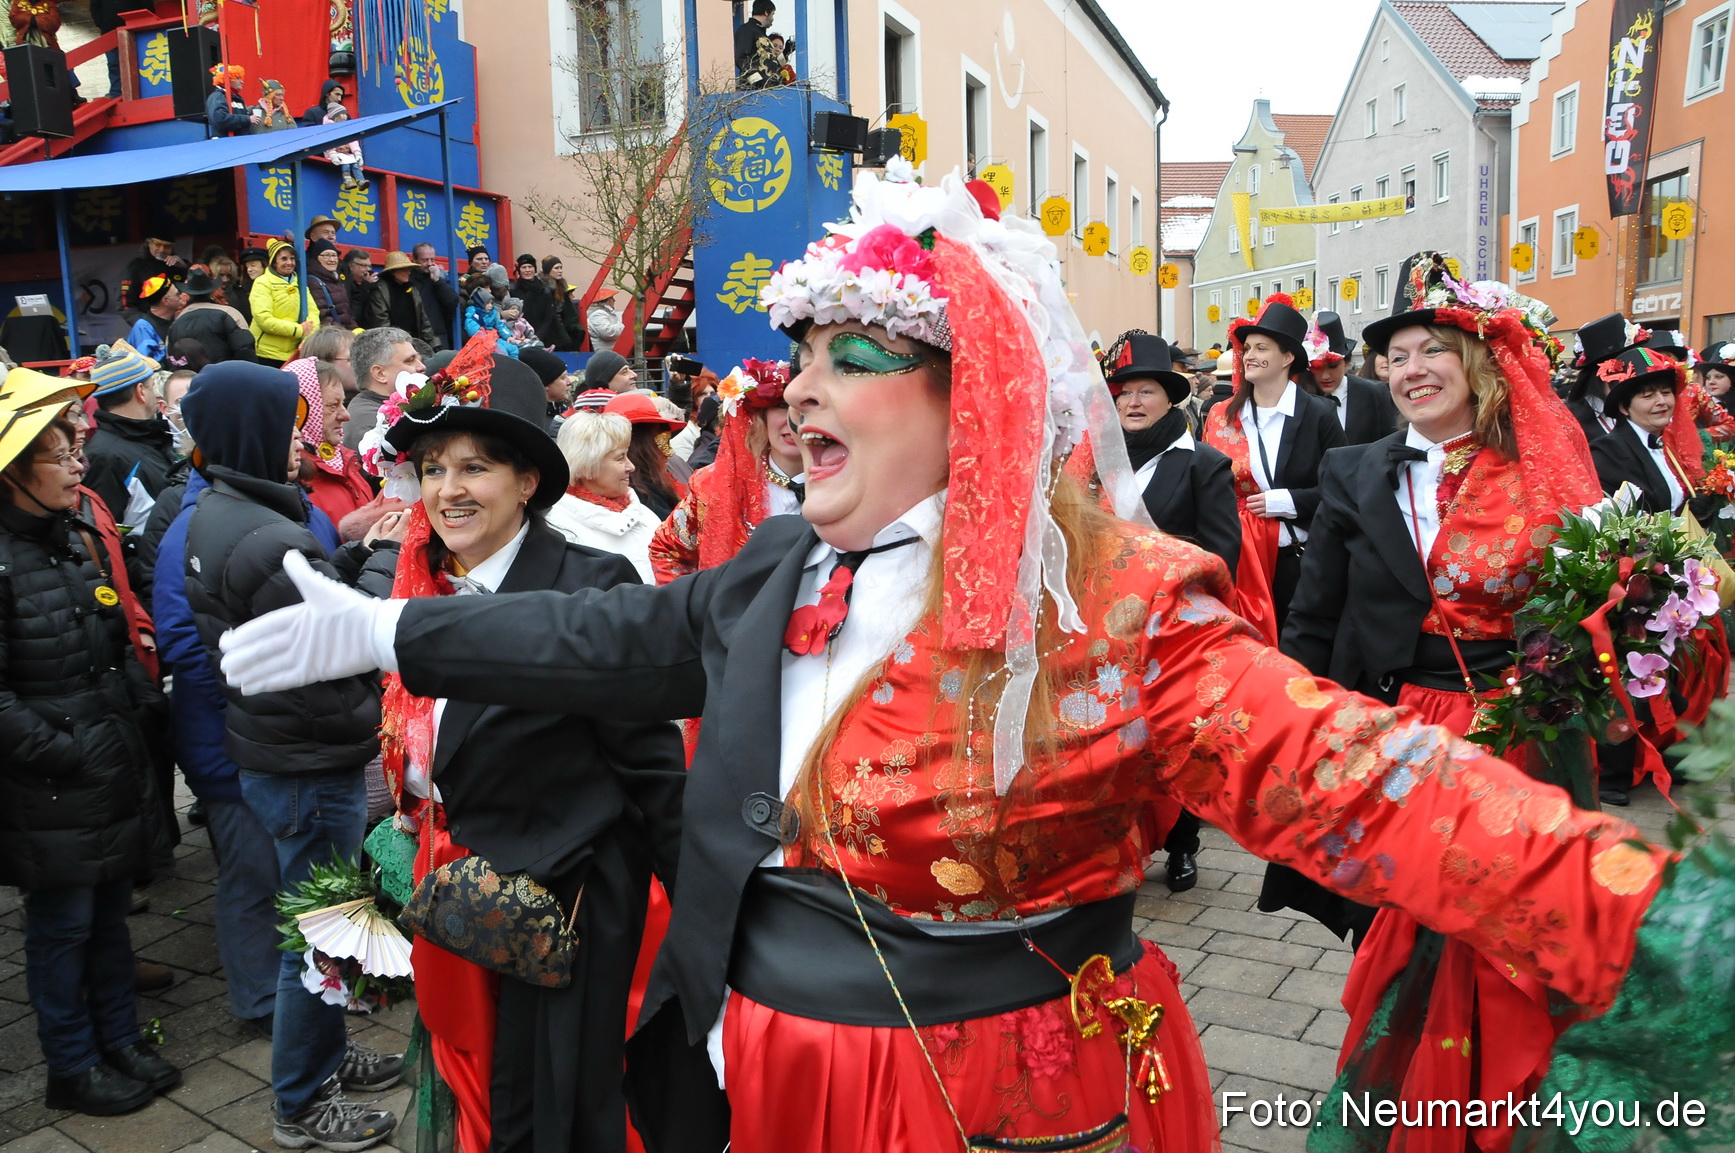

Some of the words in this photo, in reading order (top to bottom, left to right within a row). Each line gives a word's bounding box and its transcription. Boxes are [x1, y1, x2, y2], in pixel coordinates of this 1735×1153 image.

[402, 189, 431, 230] 福
[1479, 165, 1489, 226] UHREN
[1631, 291, 1682, 315] GÖTZ
